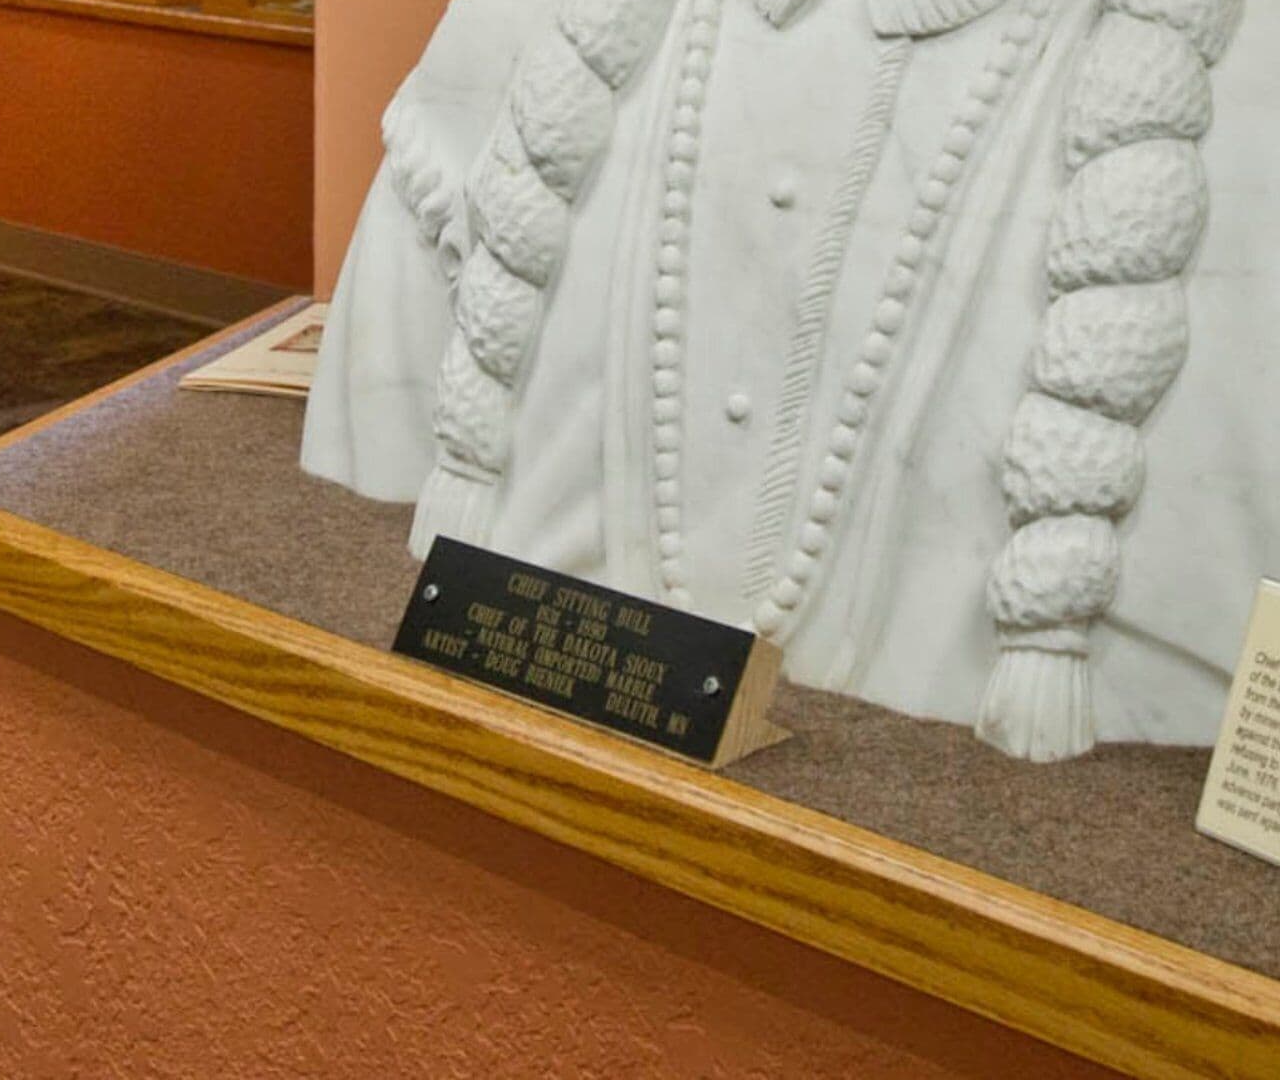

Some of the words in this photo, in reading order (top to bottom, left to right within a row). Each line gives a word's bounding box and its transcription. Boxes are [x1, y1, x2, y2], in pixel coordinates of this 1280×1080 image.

[508, 573, 549, 599] CHIEF
[553, 587, 610, 620] SITTING
[615, 607, 650, 635] BULL
[468, 602, 503, 627] CHIEF
[508, 616, 528, 635] OF
[533, 623, 557, 647] THE
[562, 634, 616, 666] DAKOTA
[622, 654, 663, 683] SIOUX
[478, 627, 527, 658] NATURAL
[606, 671, 653, 700] MARBLE
[424, 629, 467, 657] ARTIST
[484, 650, 521, 676] DOUG
[667, 713, 686, 734] MN
[1249, 671, 1262, 682] of
[1261, 674, 1276, 688] the
[1245, 687, 1266, 704] from
[1239, 705, 1251, 720] by
[1235, 726, 1270, 745] against
[1231, 744, 1268, 768] refusing
[1268, 756, 1279, 770] to
[1216, 799, 1236, 813] was
